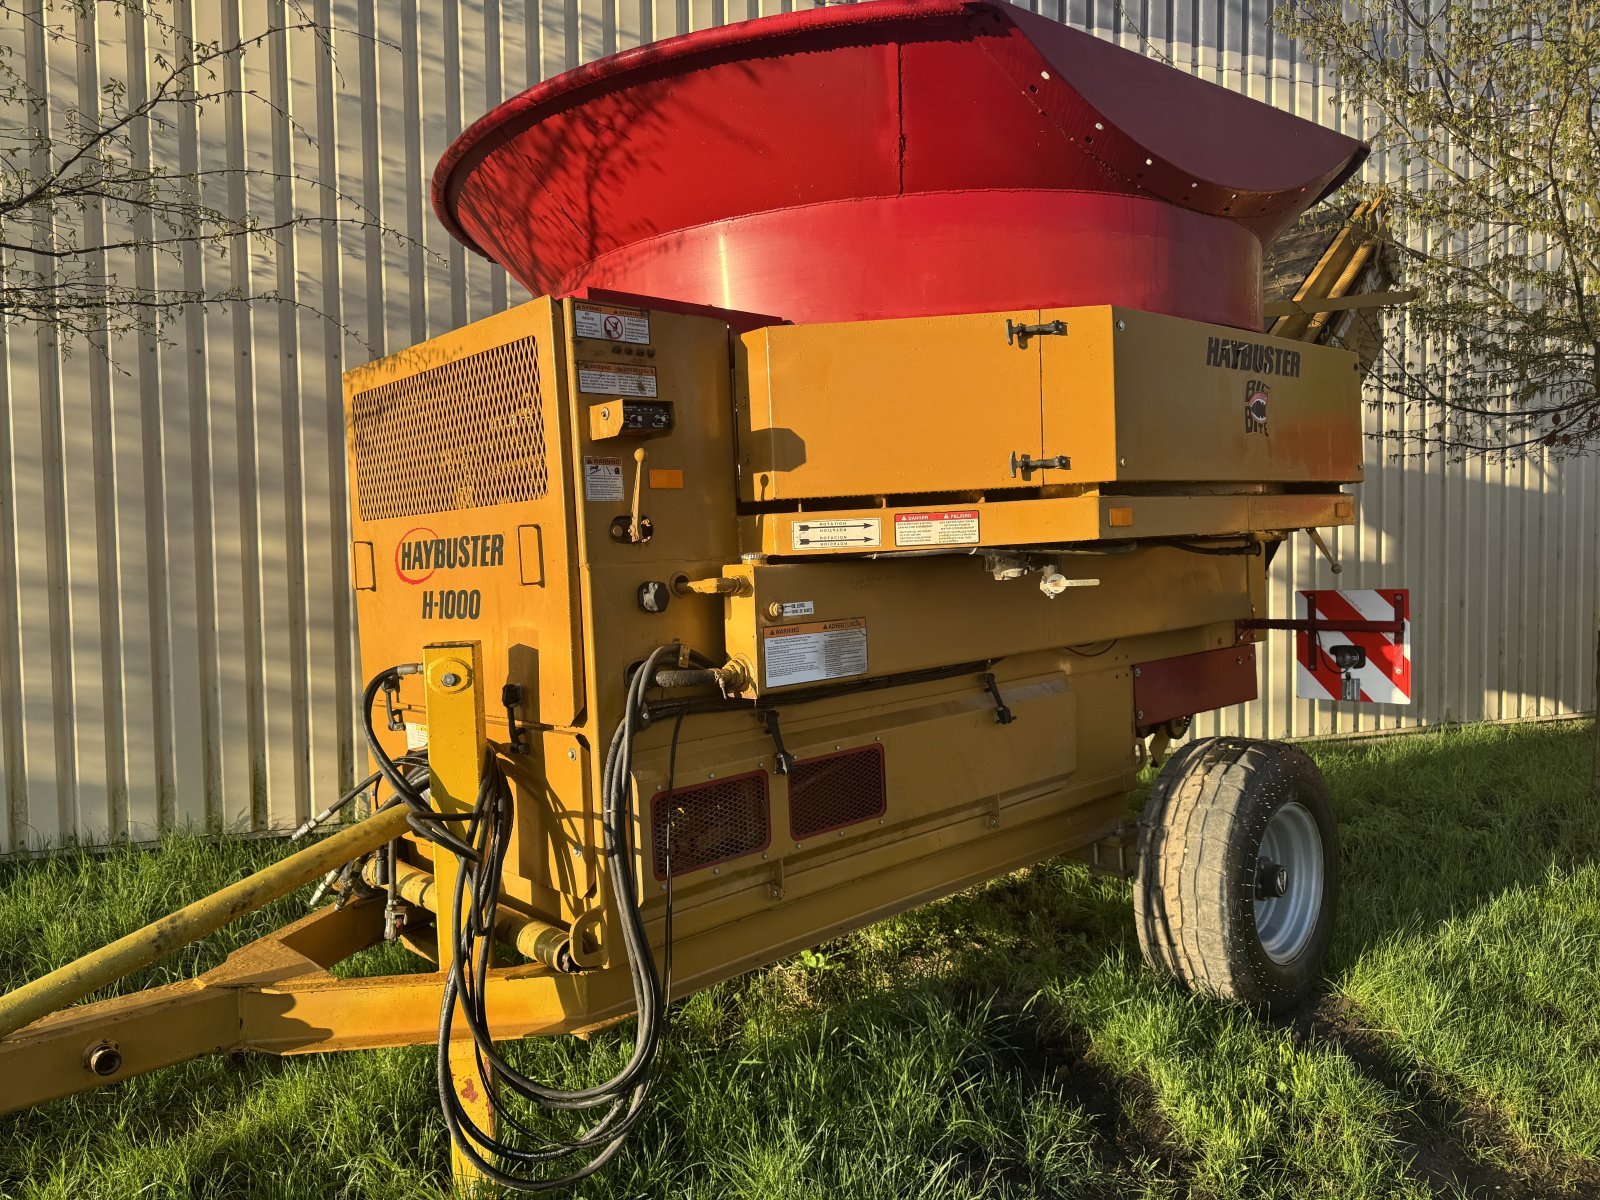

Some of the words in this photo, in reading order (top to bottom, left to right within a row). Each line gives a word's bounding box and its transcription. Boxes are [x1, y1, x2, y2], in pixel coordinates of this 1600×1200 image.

[1206, 336, 1301, 378] HAYBUSTER
[401, 533, 504, 571] HAYBUSTER
[421, 589, 481, 620] H-1000
